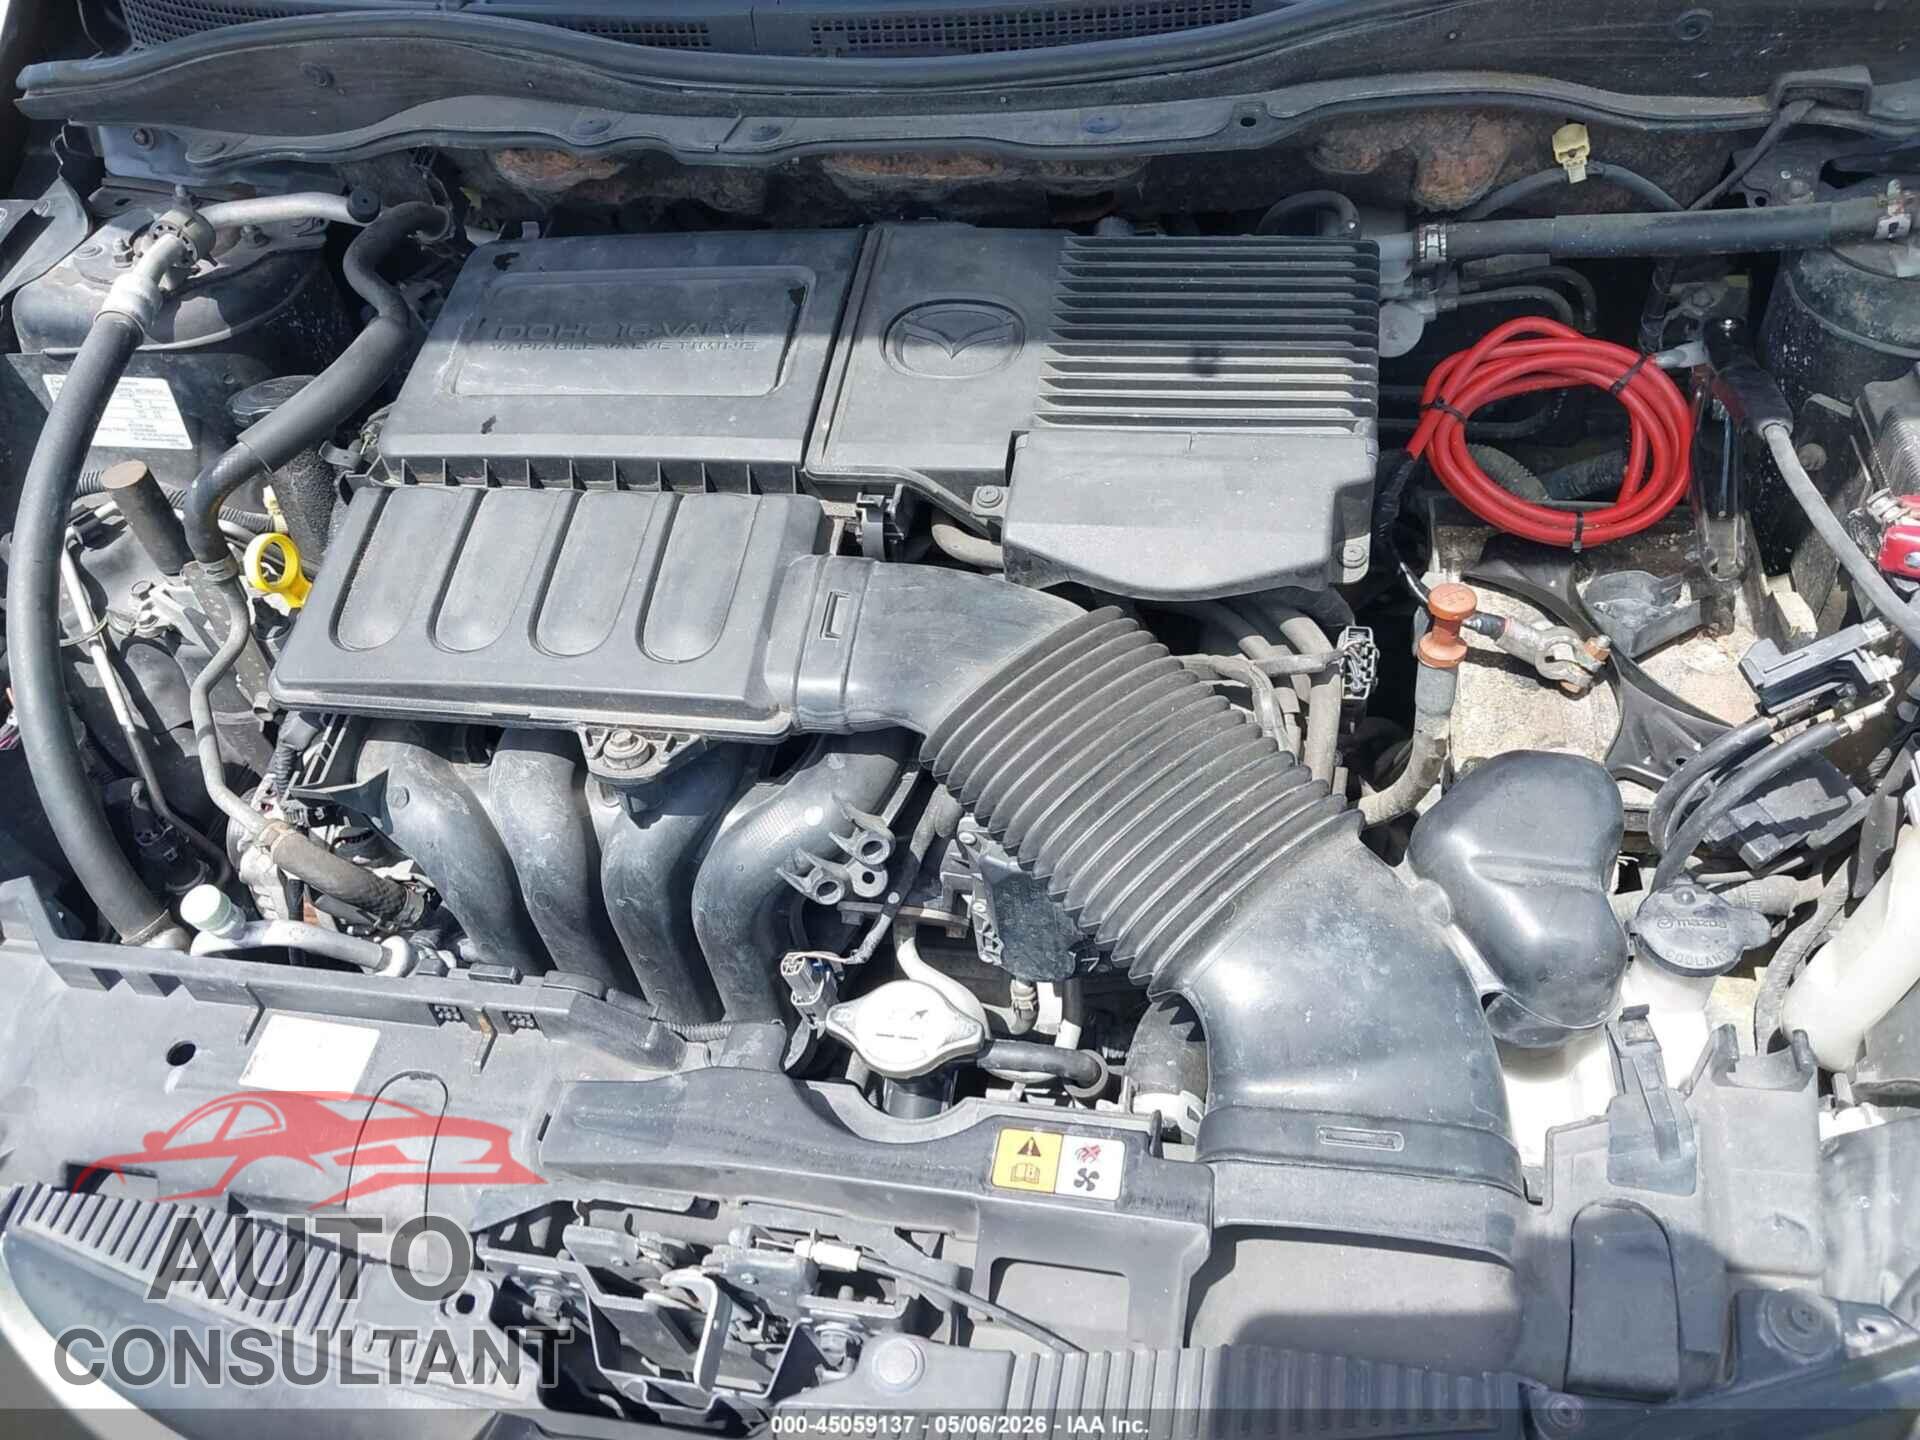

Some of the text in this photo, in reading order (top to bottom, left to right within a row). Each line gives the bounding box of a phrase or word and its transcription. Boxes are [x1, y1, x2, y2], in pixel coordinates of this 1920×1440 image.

[494, 320, 596, 340] DOHC
[604, 341, 674, 352] VALVE
[680, 341, 761, 352] TIMING
